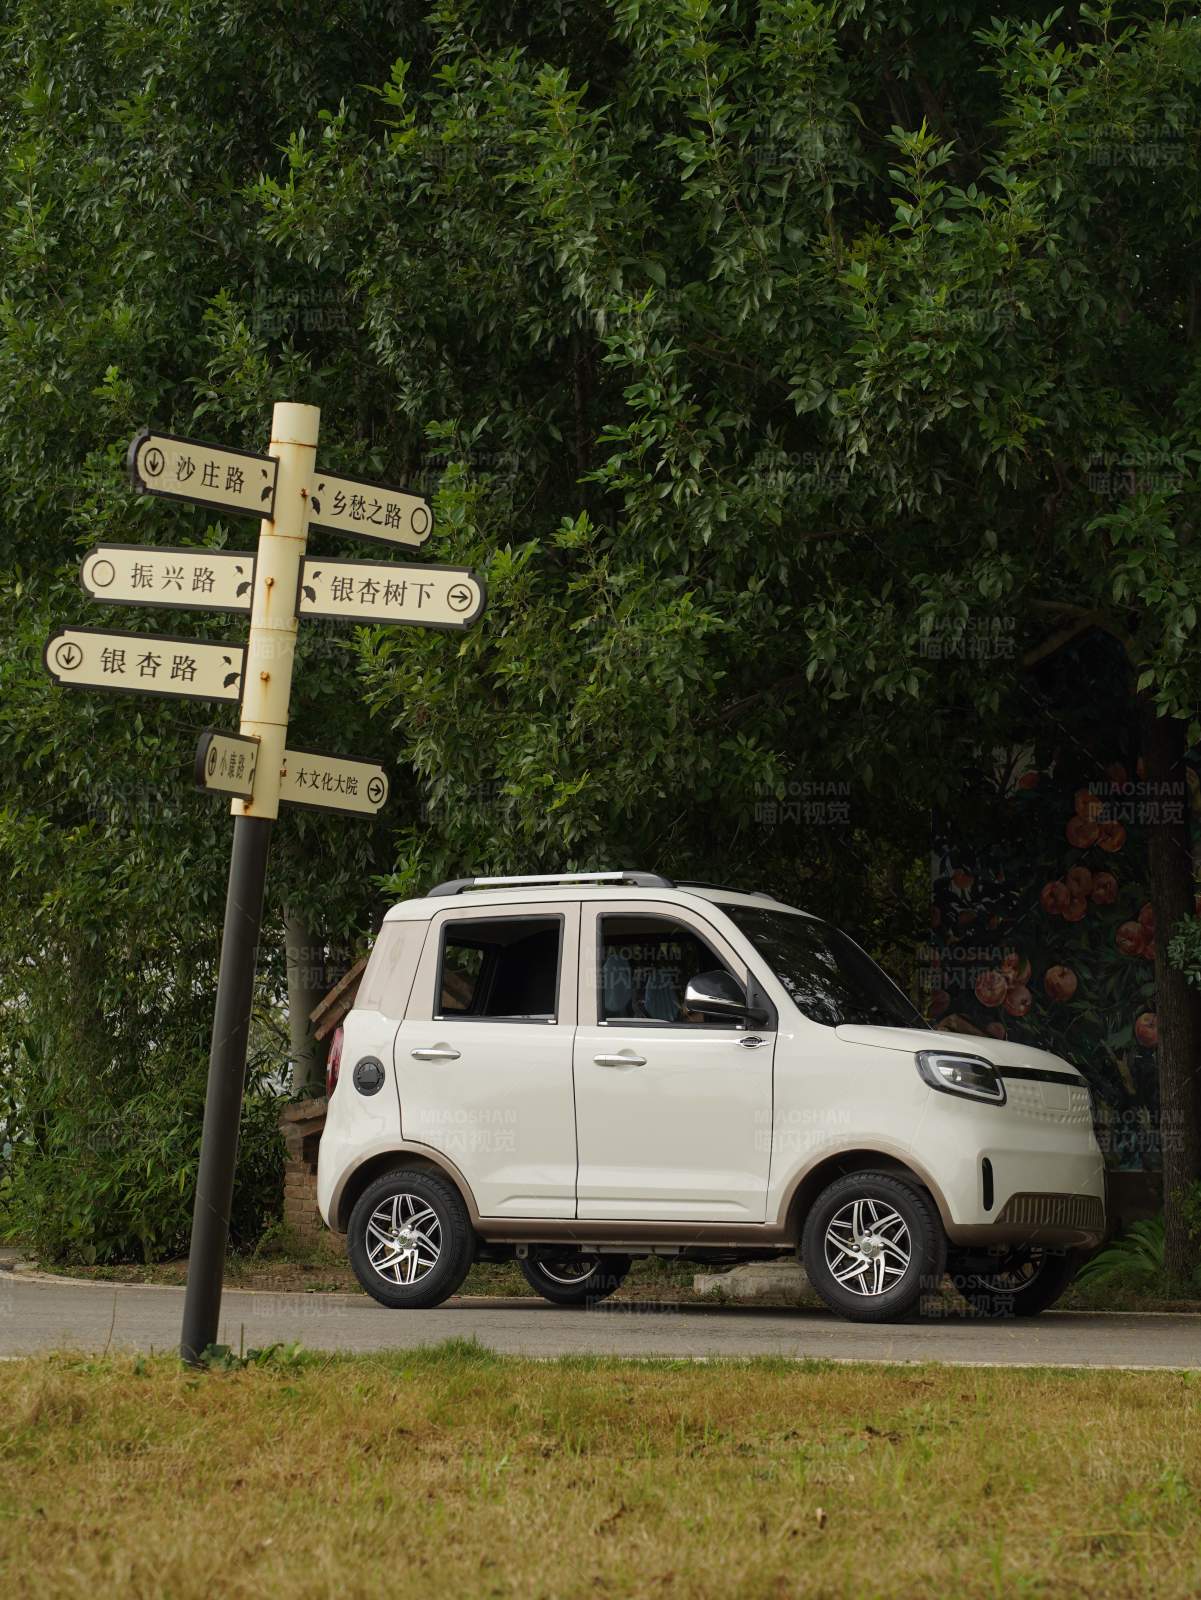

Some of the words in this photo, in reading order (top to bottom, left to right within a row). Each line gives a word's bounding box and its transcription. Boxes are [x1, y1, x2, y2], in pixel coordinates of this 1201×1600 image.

[176, 455, 245, 494] 沙庄路
[330, 490, 403, 530] 乡愁之路
[130, 563, 216, 594] 振兴路
[330, 575, 436, 609] 银杏树下
[100, 647, 198, 683] 银杏路
